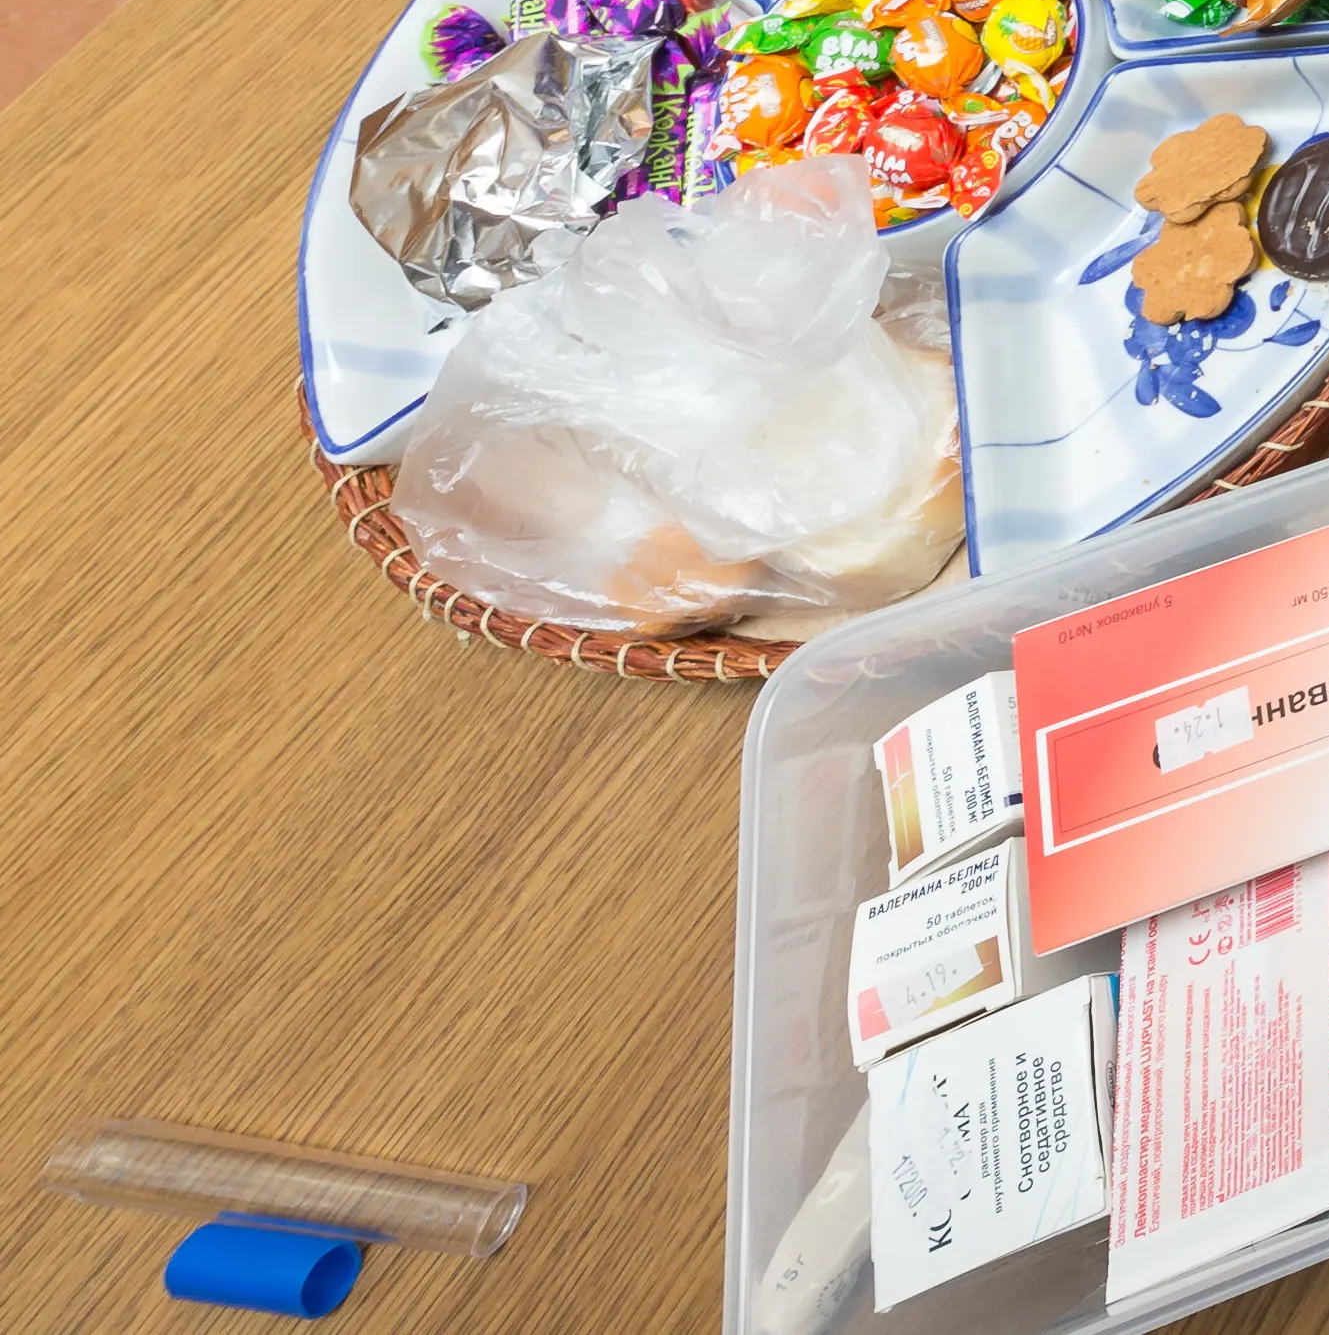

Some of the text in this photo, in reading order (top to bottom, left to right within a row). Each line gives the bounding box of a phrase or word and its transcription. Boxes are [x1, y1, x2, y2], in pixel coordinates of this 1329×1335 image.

[821, 33, 879, 59] BIM
[1056, 594, 1174, 645] 5 упаковок №10
[1289, 592, 1309, 607] мг
[924, 727, 936, 783] покрытых
[942, 765, 952, 783] 50
[966, 690, 993, 820] ВАЛЕРИАНА-БЕЛМЕД
[964, 786, 978, 827] 200 мг
[868, 853, 999, 920] ВАЛЕРИАНА-БЕЛМЕД
[961, 869, 998, 894] 200 мг
[876, 933, 932, 965] покрытых
[926, 913, 940, 929] 50
[1147, 914, 1157, 939] осн
[1146, 978, 1154, 995] на
[1141, 997, 1153, 1065] LUXPLAST
[1012, 1051, 1036, 1195] Снотворное и
[1031, 1053, 1052, 1175] седативное
[1049, 1057, 1069, 1155] средство
[1139, 1063, 1152, 1135] медичний
[978, 1100, 991, 1179] раствор для
[987, 1056, 1004, 1214] внутреннего применения
[1135, 1133, 1150, 1240] Лейкопластир
